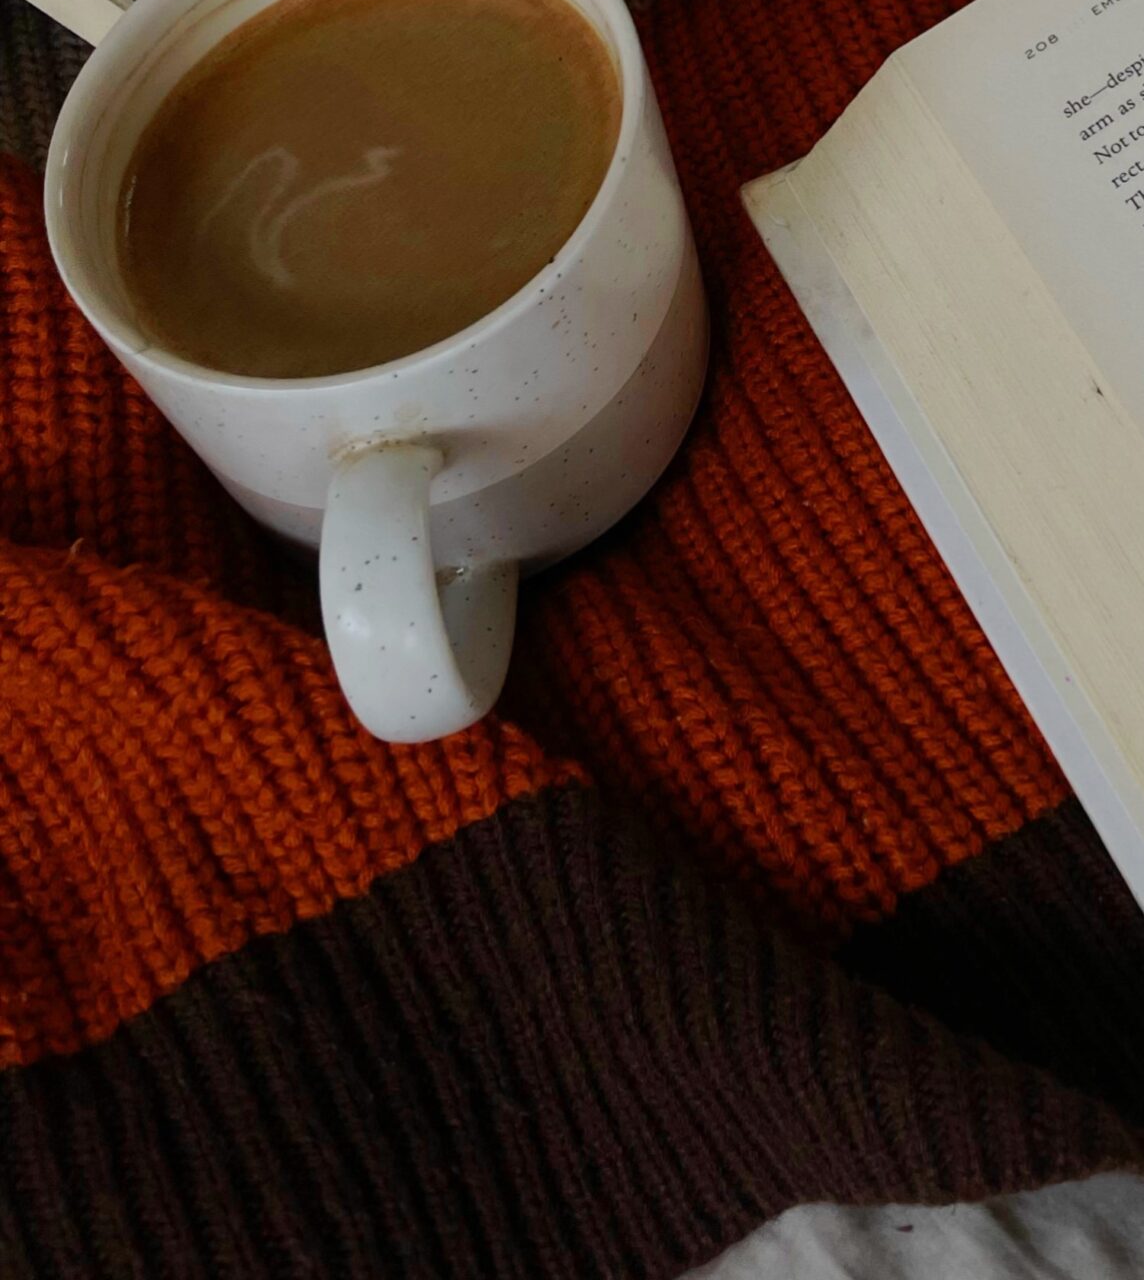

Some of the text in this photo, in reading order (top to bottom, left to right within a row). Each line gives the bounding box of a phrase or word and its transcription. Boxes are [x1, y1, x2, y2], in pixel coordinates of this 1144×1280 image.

[1023, 33, 1060, 61] 208
[1079, 113, 1115, 142] arm
[1117, 98, 1137, 116] as
